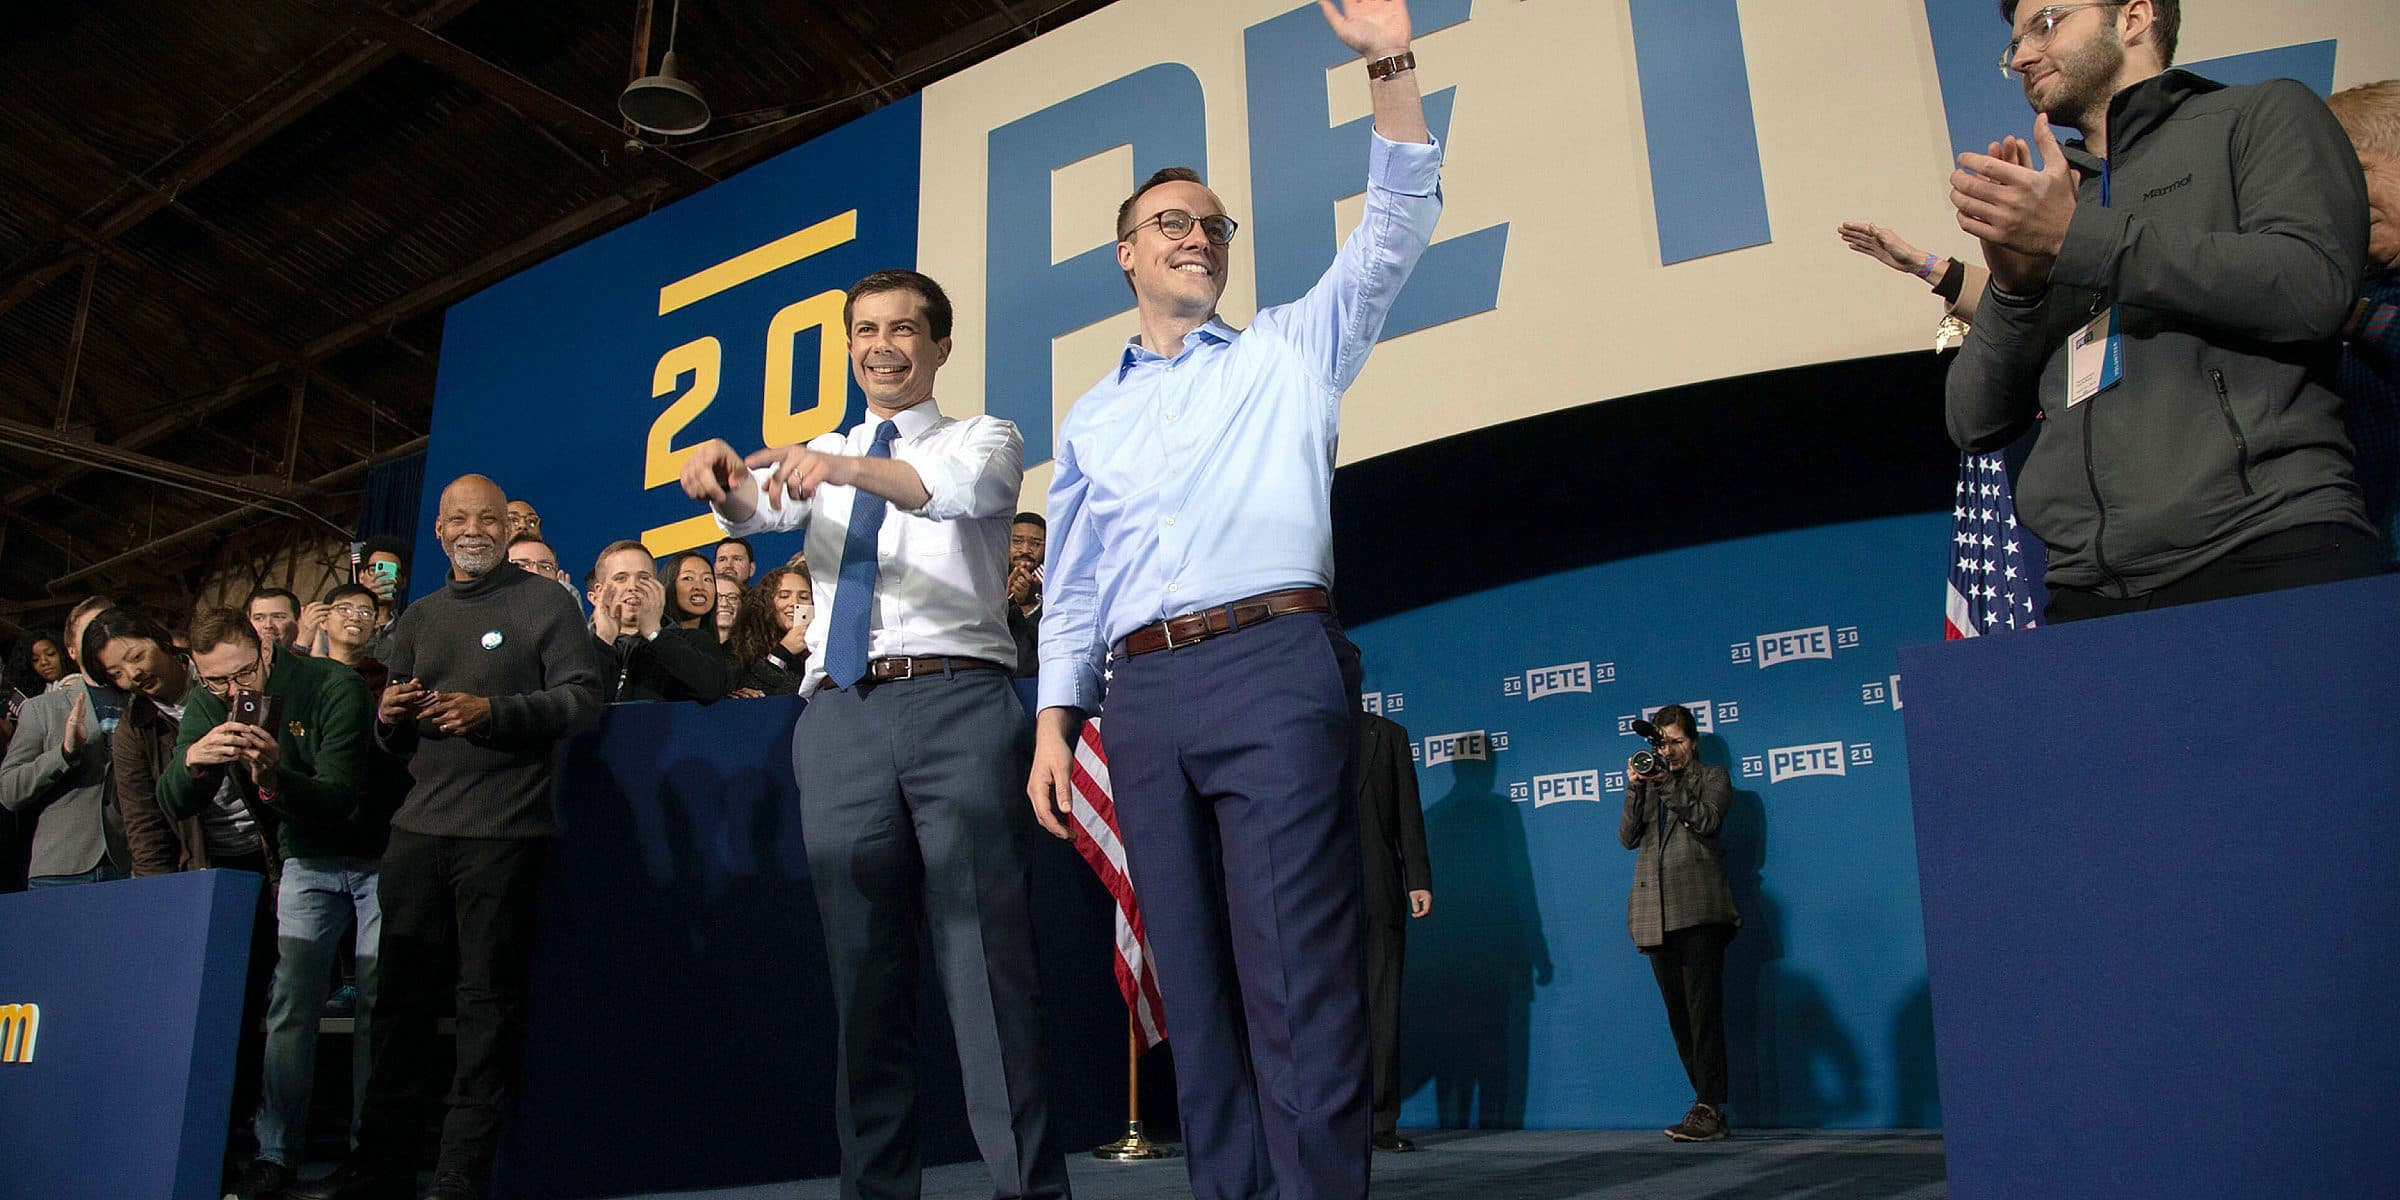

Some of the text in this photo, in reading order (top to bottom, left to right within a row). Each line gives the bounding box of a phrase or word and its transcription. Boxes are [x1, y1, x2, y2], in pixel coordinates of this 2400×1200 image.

[2143, 173, 2192, 201] Marmot
[644, 289, 849, 490] 20
[1731, 631, 1858, 661] 20 PETE 20
[1504, 667, 1615, 694] 20 PETE 20
[1387, 697, 1404, 708] 20
[1863, 688, 1884, 700] 20
[1718, 706, 1738, 719] 20
[1429, 736, 1481, 761] PETE
[1491, 736, 1508, 747] 20
[1742, 747, 1872, 776] 20 PETE 20
[1510, 775, 1624, 801] 20 PETE 20
